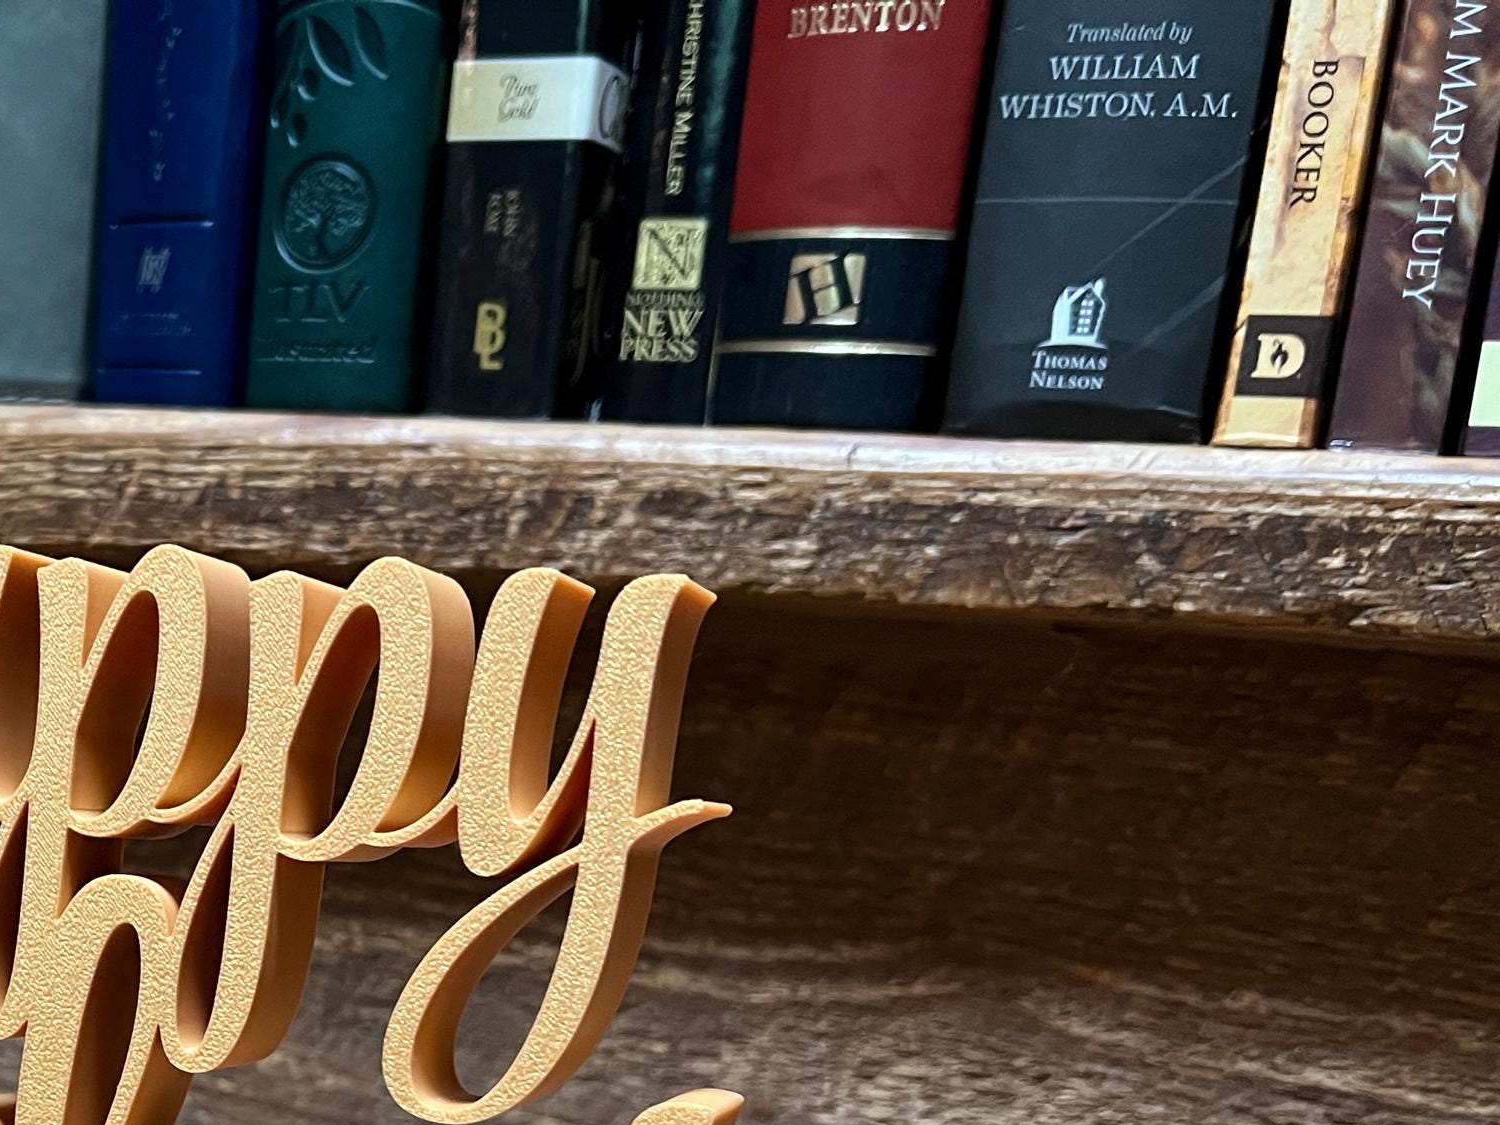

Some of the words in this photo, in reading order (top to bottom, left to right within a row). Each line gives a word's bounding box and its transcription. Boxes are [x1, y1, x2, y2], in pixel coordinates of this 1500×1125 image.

[787, 0, 946, 38] BRENTON
[1067, 19, 1169, 43] Translated
[1169, 20, 1193, 45] by
[675, 0, 705, 107] HRISTINE
[1049, 53, 1201, 80] WILLIAM
[1163, 91, 1238, 118] A.M.
[1424, 51, 1482, 178] MARK
[1289, 59, 1340, 209] BOOKER
[664, 111, 695, 196] MILLER
[1402, 192, 1456, 310] HUEY
[623, 307, 704, 338] NEW
[619, 335, 698, 364] PRESS
[1031, 350, 1108, 371] THOMAS
[1029, 371, 1105, 390] NELSON
